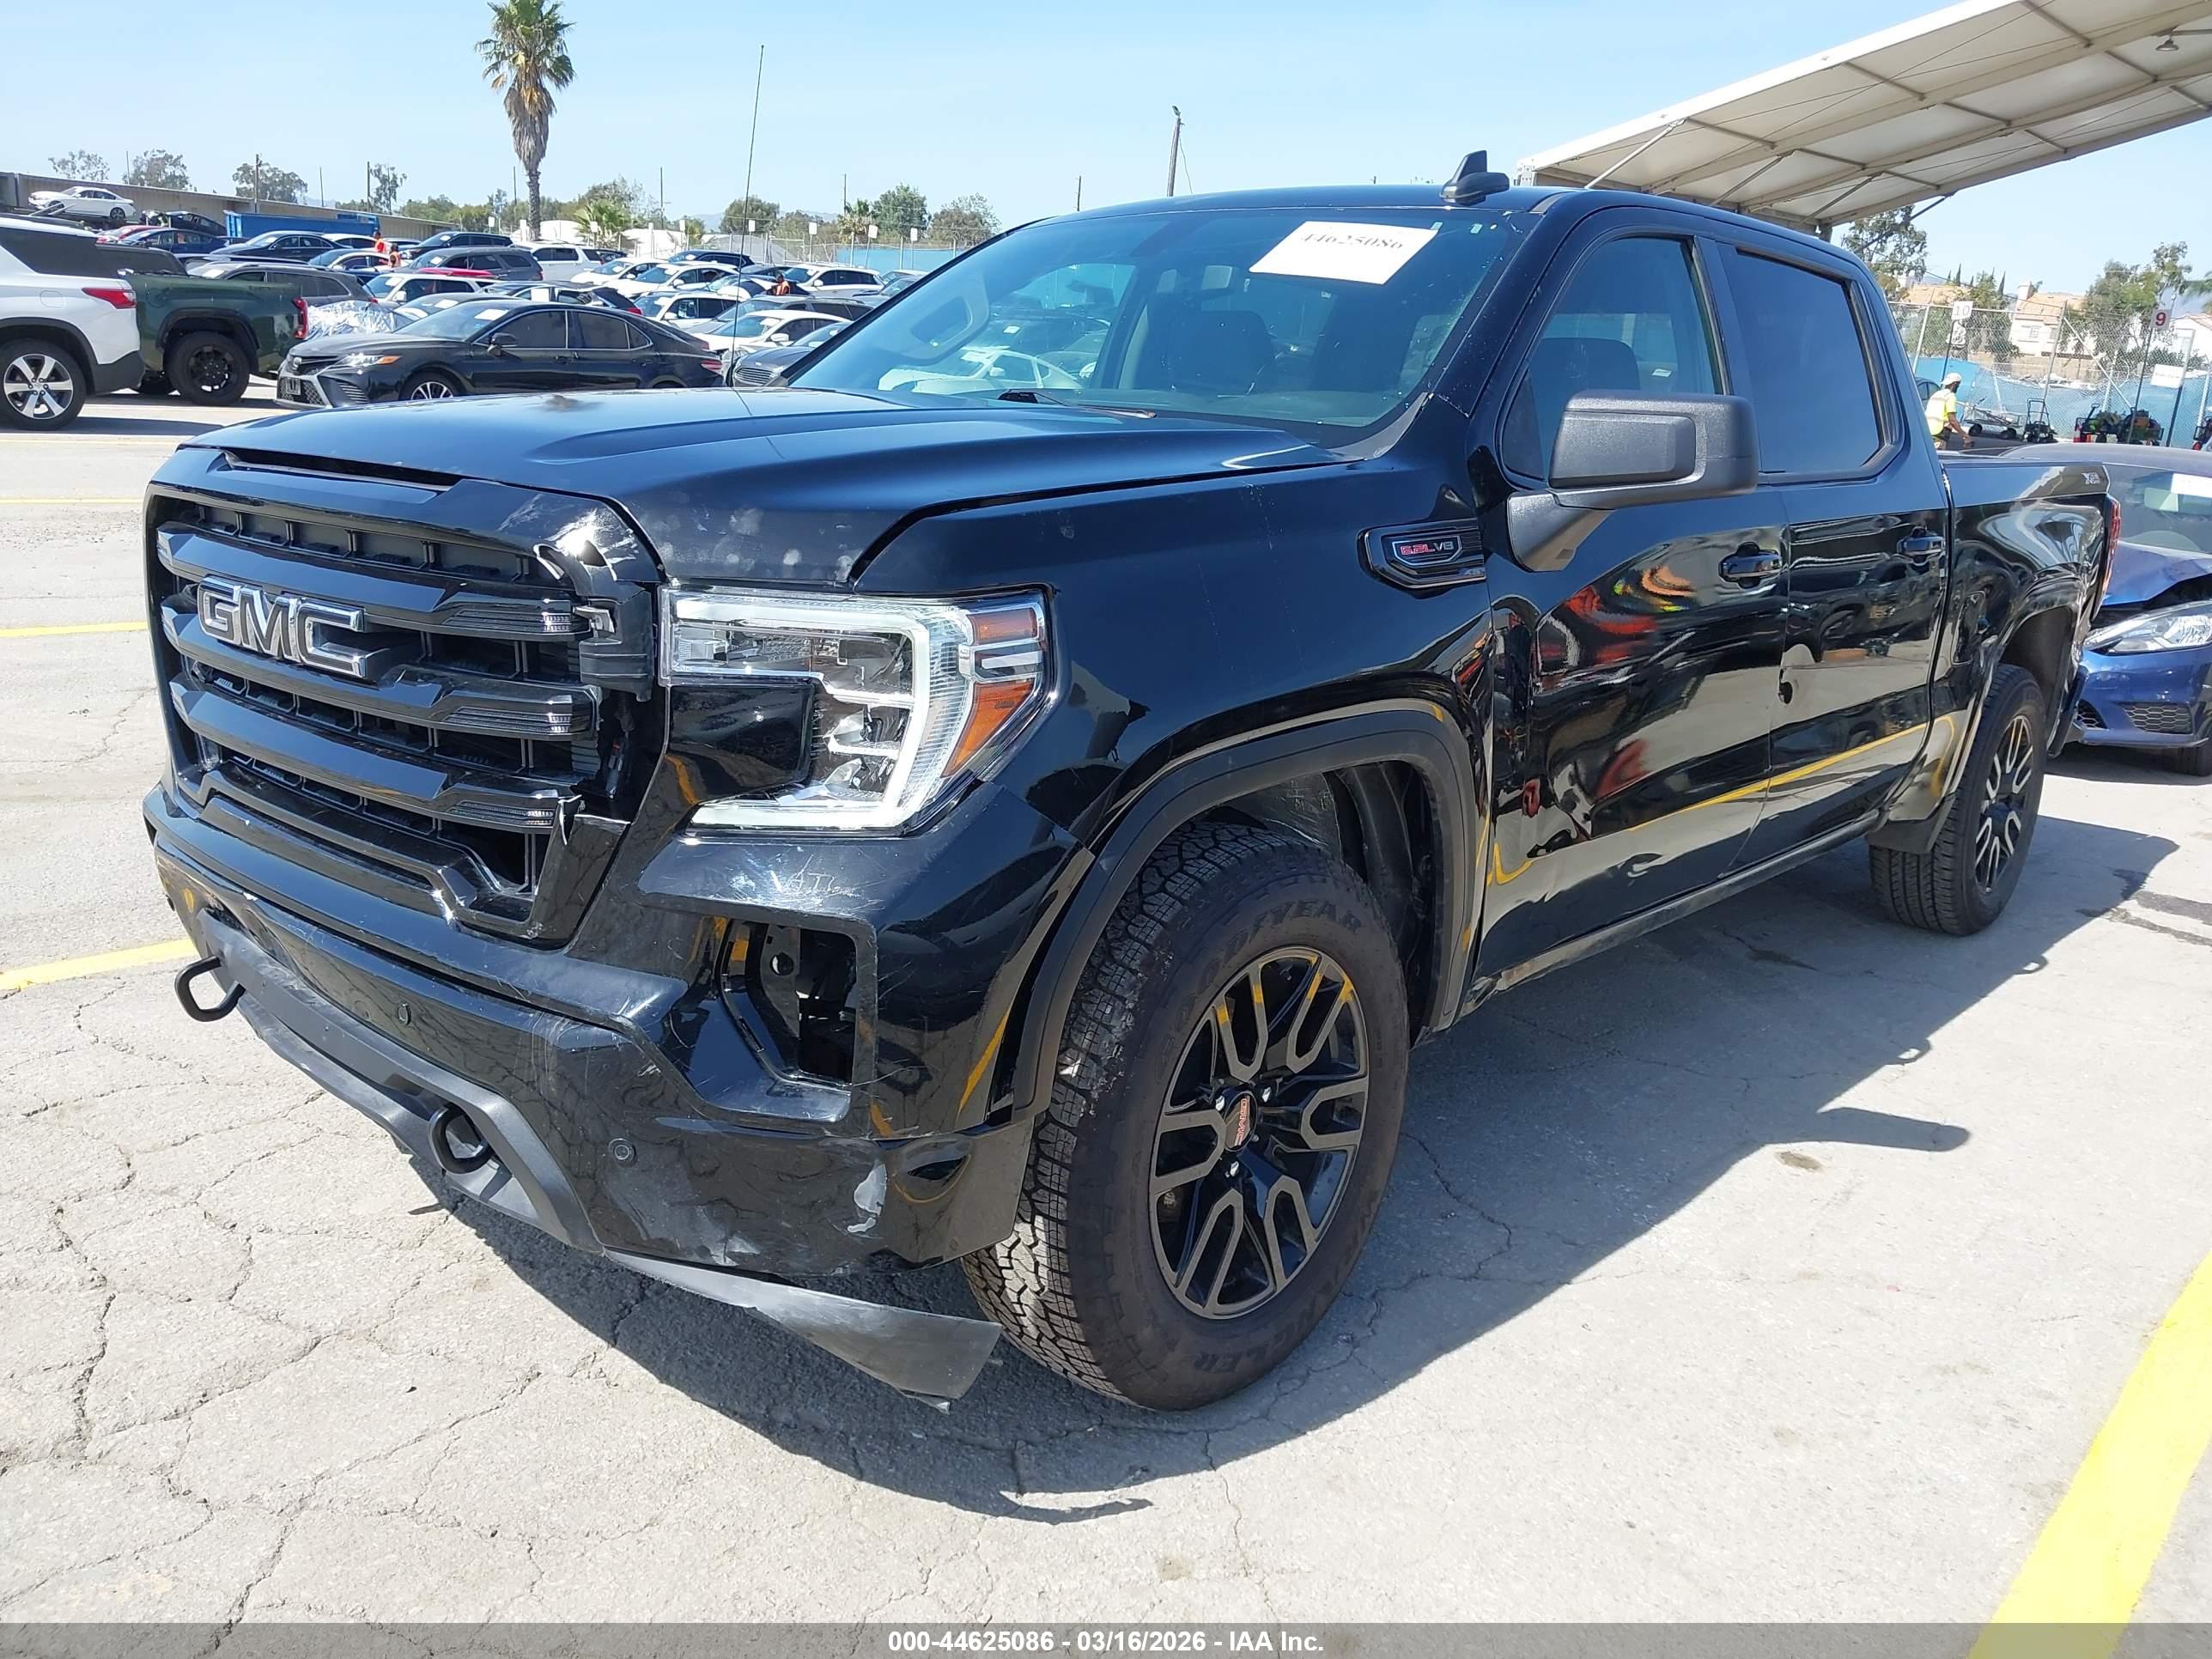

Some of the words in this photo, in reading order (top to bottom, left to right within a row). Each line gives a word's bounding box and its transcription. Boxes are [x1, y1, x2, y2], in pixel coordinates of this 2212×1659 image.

[2155, 312, 2166, 326] 9
[198, 574, 368, 678] GMC
[1234, 1097, 1249, 1146] GMC
